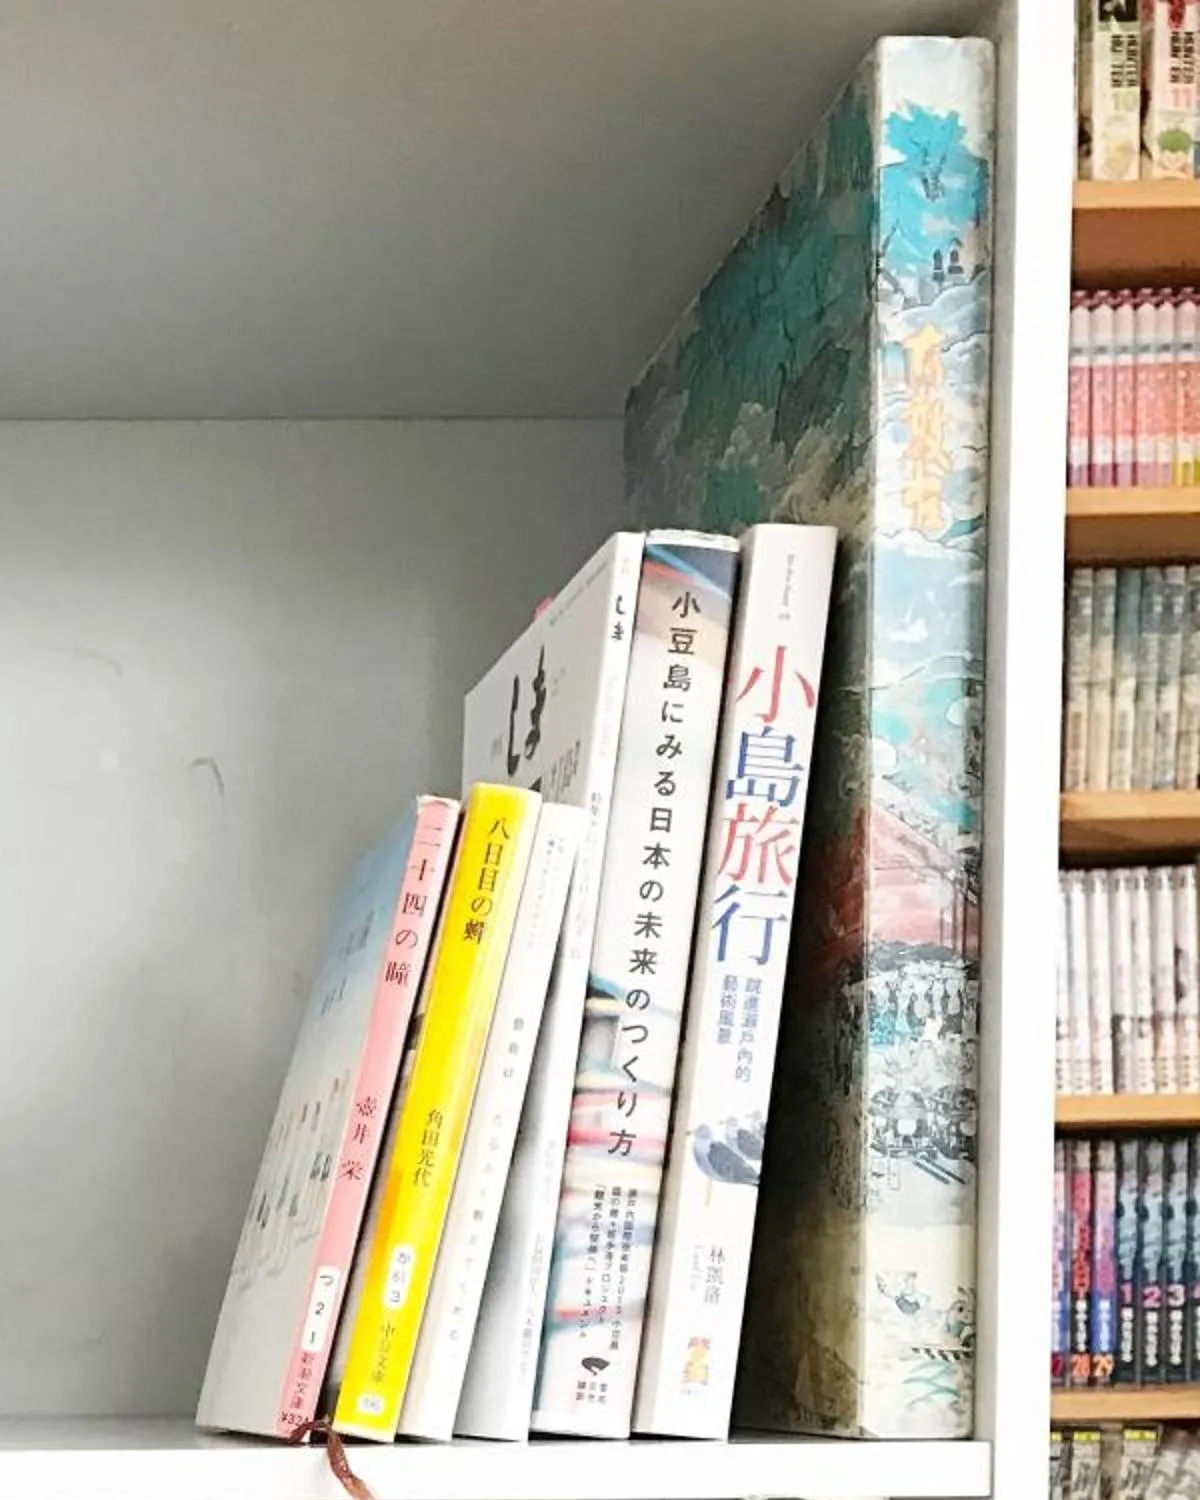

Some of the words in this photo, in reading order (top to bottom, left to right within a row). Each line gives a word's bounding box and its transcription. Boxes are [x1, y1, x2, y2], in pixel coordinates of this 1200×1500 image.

[606, 590, 702, 1158] 小豆島にみる日本の未来のつくり方
[712, 645, 818, 965] 小島旅行
[385, 825, 443, 987] 二十四の瞳
[1144, 1284, 1161, 1308] 2
[1167, 1284, 1185, 1307] 3
